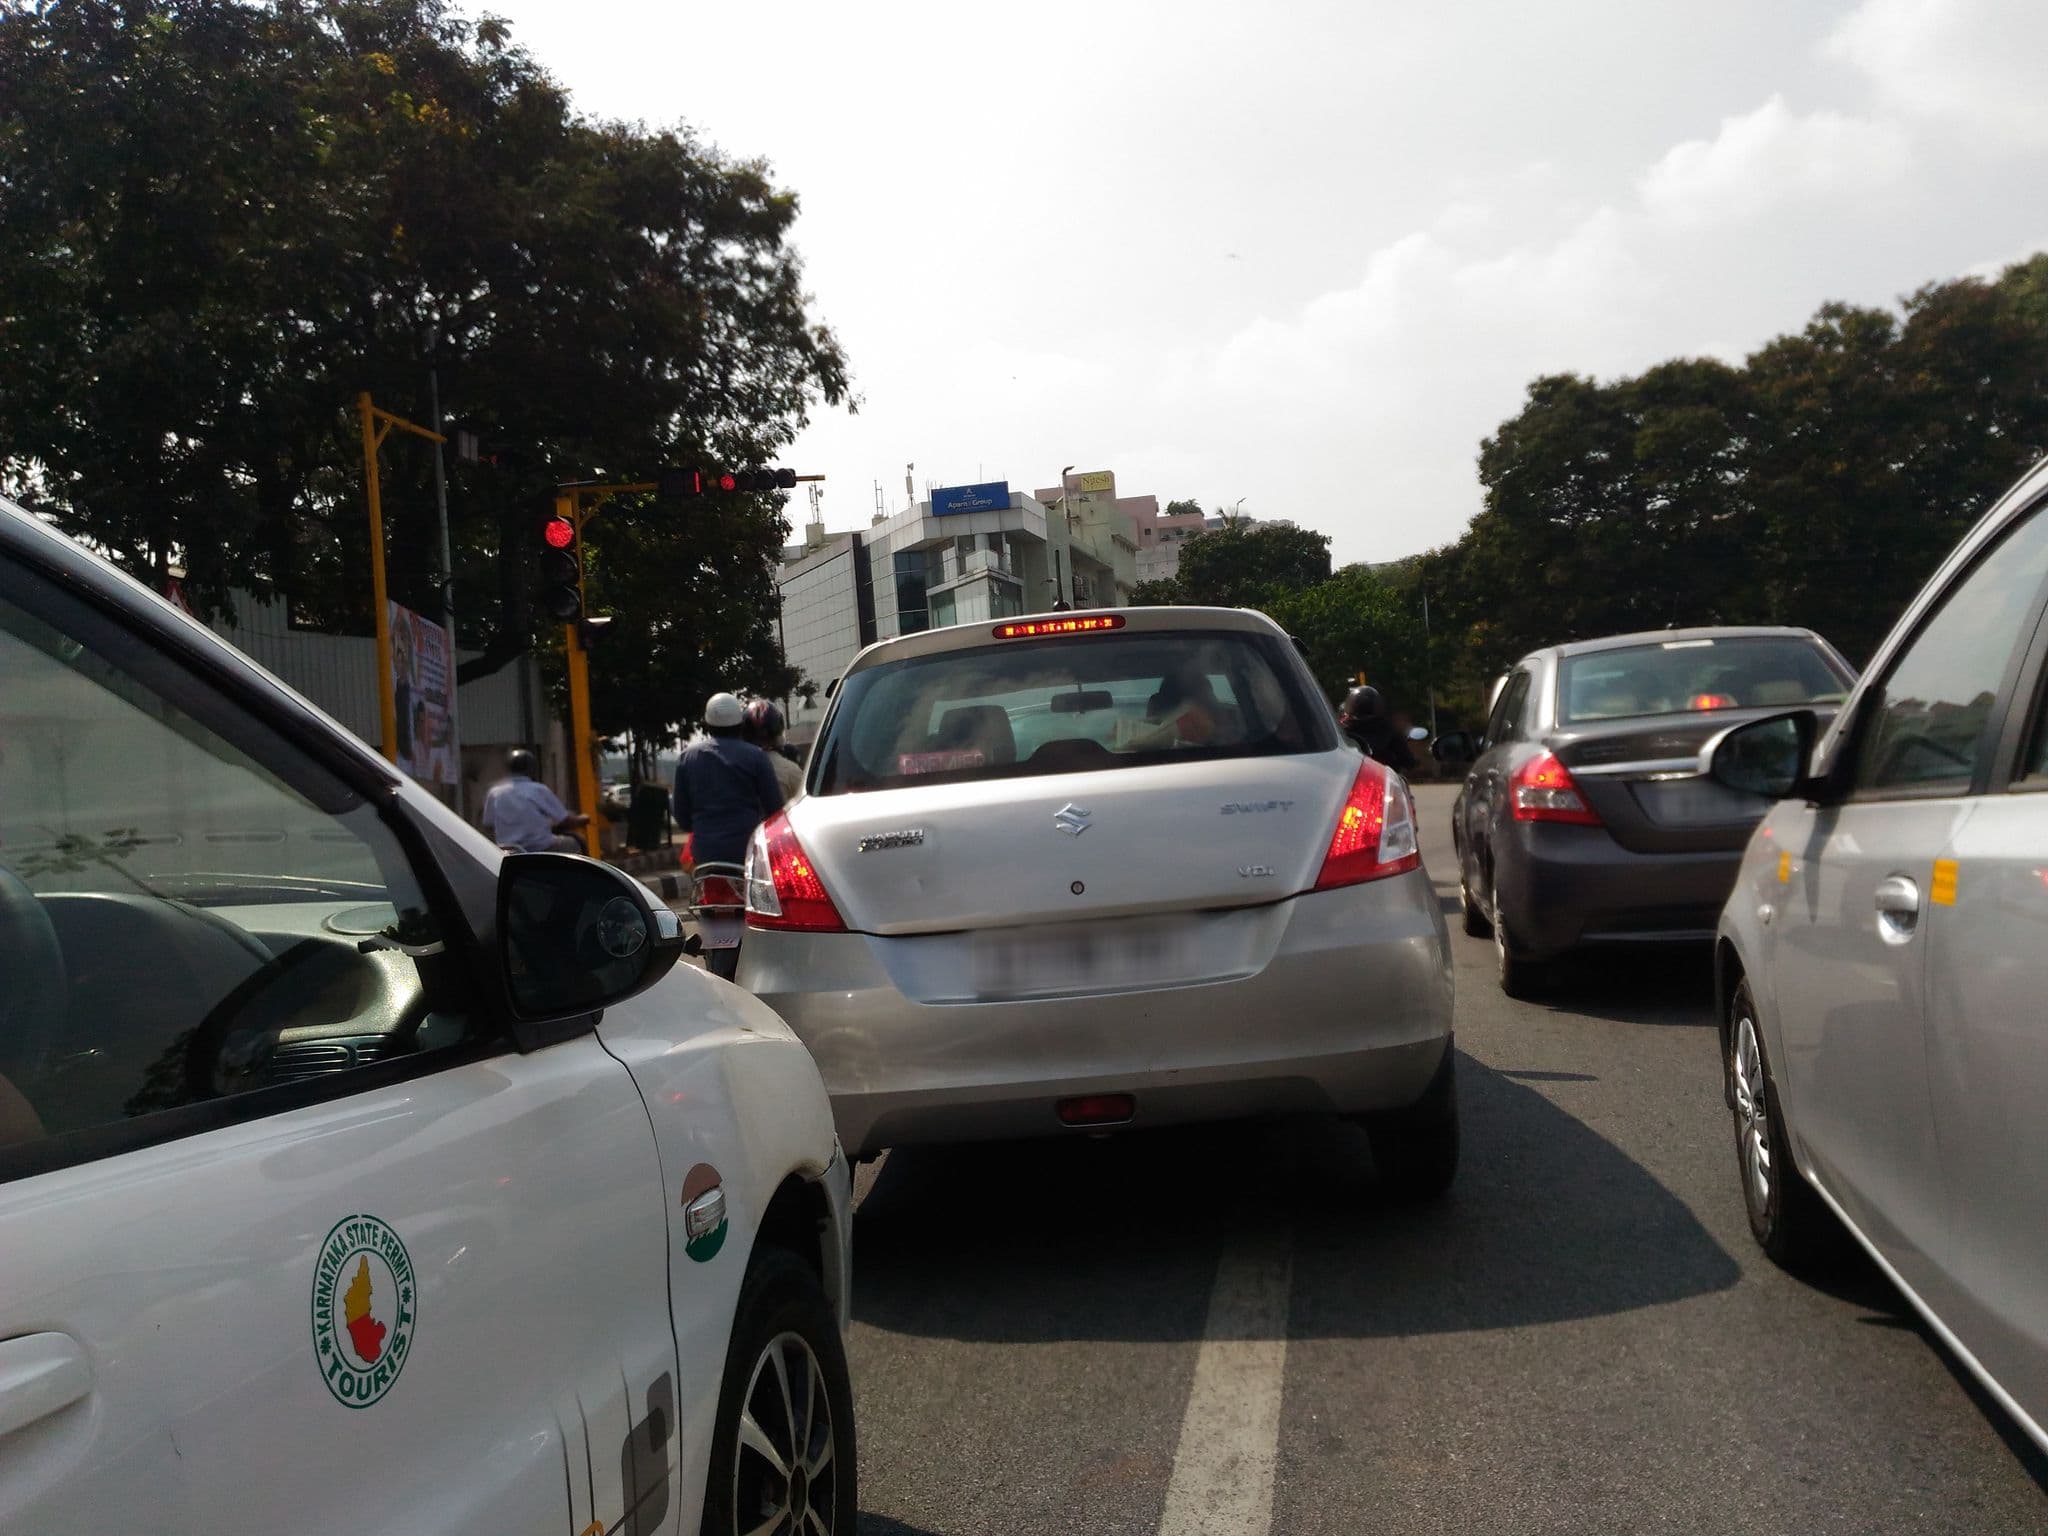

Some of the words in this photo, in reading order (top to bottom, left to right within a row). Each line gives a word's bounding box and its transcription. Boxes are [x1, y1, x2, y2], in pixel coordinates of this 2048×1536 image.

[1220, 799, 1294, 815] SWIFT
[316, 1234, 350, 1336] KARNATAKA
[346, 1222, 379, 1249] STATE
[380, 1232, 411, 1287] PERMIT
[327, 1304, 412, 1401] TOURIST
